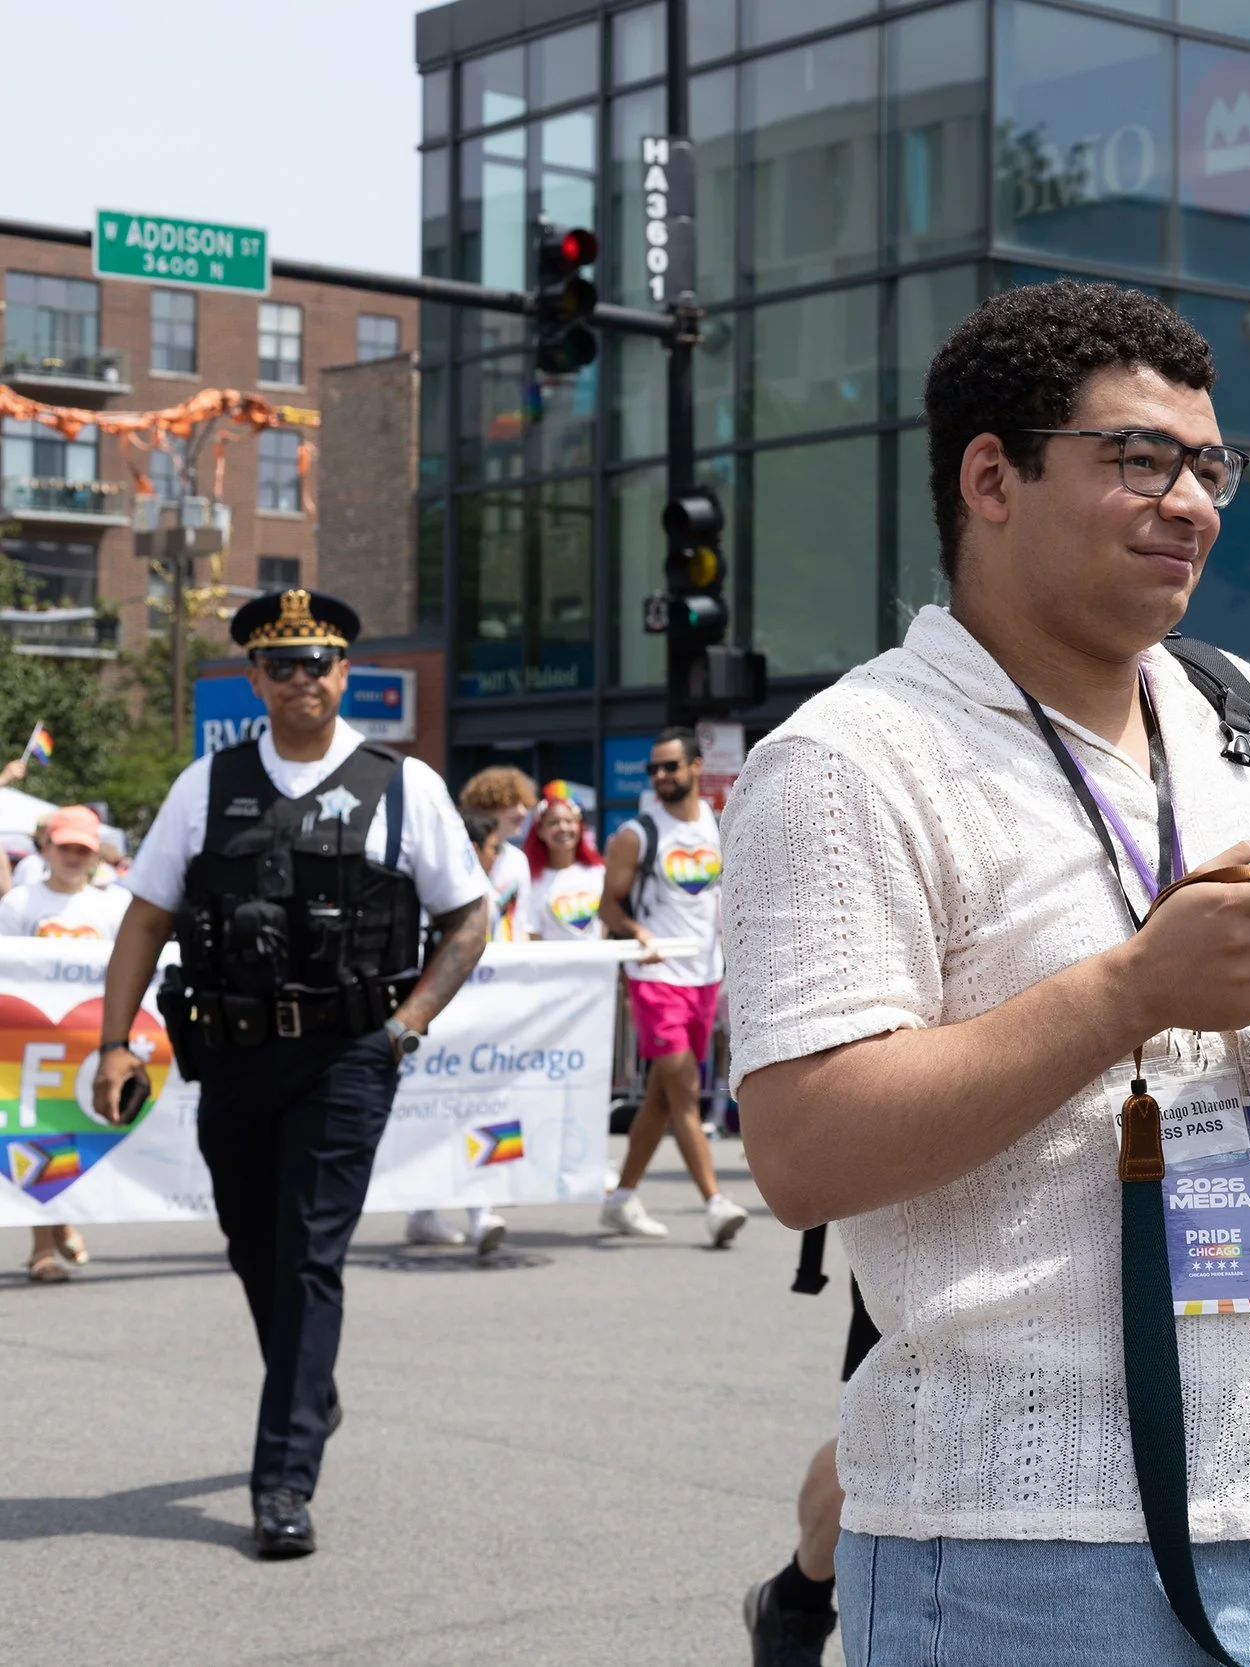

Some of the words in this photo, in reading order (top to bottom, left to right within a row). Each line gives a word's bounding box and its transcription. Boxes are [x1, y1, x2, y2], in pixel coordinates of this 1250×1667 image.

[643, 138, 670, 301] HA3601
[103, 220, 119, 242] W
[124, 218, 234, 258] ADDISON
[240, 237, 260, 257] ST
[142, 252, 199, 277] 3600
[209, 261, 224, 280] N
[425, 1047, 462, 1076] de
[469, 1042, 585, 1082] Chicago
[1190, 1097, 1240, 1116] Maroon
[1186, 1119, 1224, 1136] PASS
[1176, 1177, 1246, 1194] 2026
[1185, 1228, 1242, 1245] PRIDE
[1188, 1246, 1241, 1257] CHICAGO
